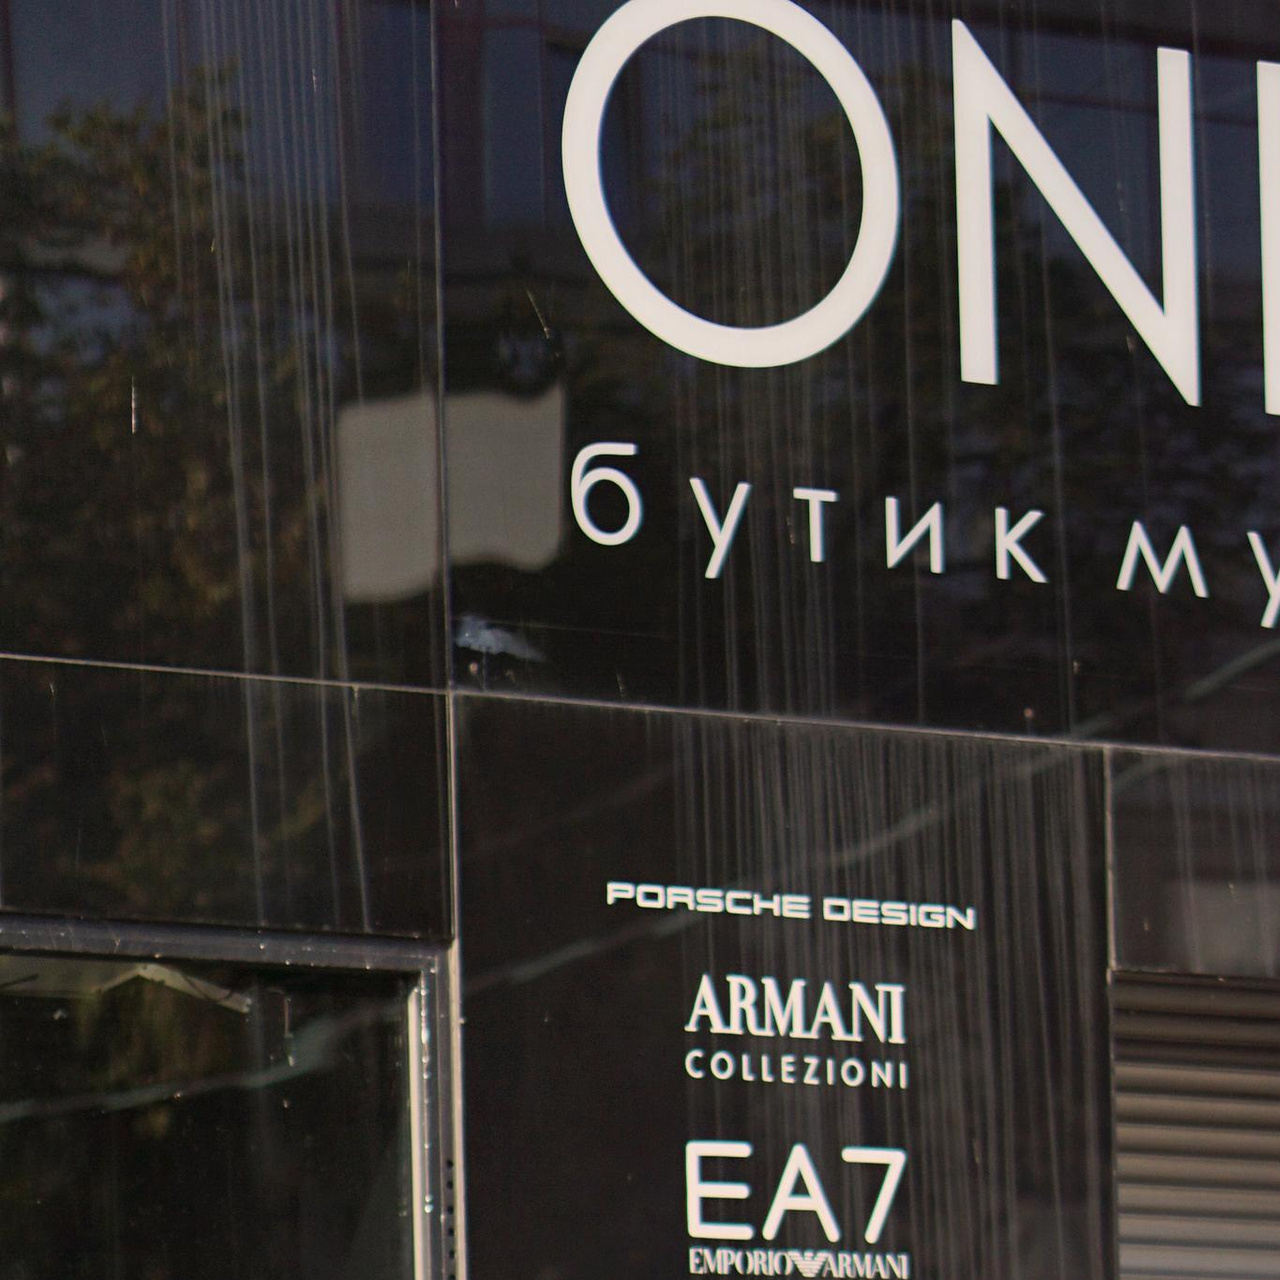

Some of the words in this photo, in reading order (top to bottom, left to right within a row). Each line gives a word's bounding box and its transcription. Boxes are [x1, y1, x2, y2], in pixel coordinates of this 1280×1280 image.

[571, 442, 1047, 580] бутик
[606, 881, 812, 919] PORSCHE
[822, 896, 976, 930] DESIGN
[684, 973, 906, 1044] ARMANI
[684, 1049, 908, 1088] COLLEZIONI
[685, 1141, 907, 1243] EA7
[688, 1247, 794, 1277] EMPORIO
[822, 1250, 909, 1280] ARMANI
